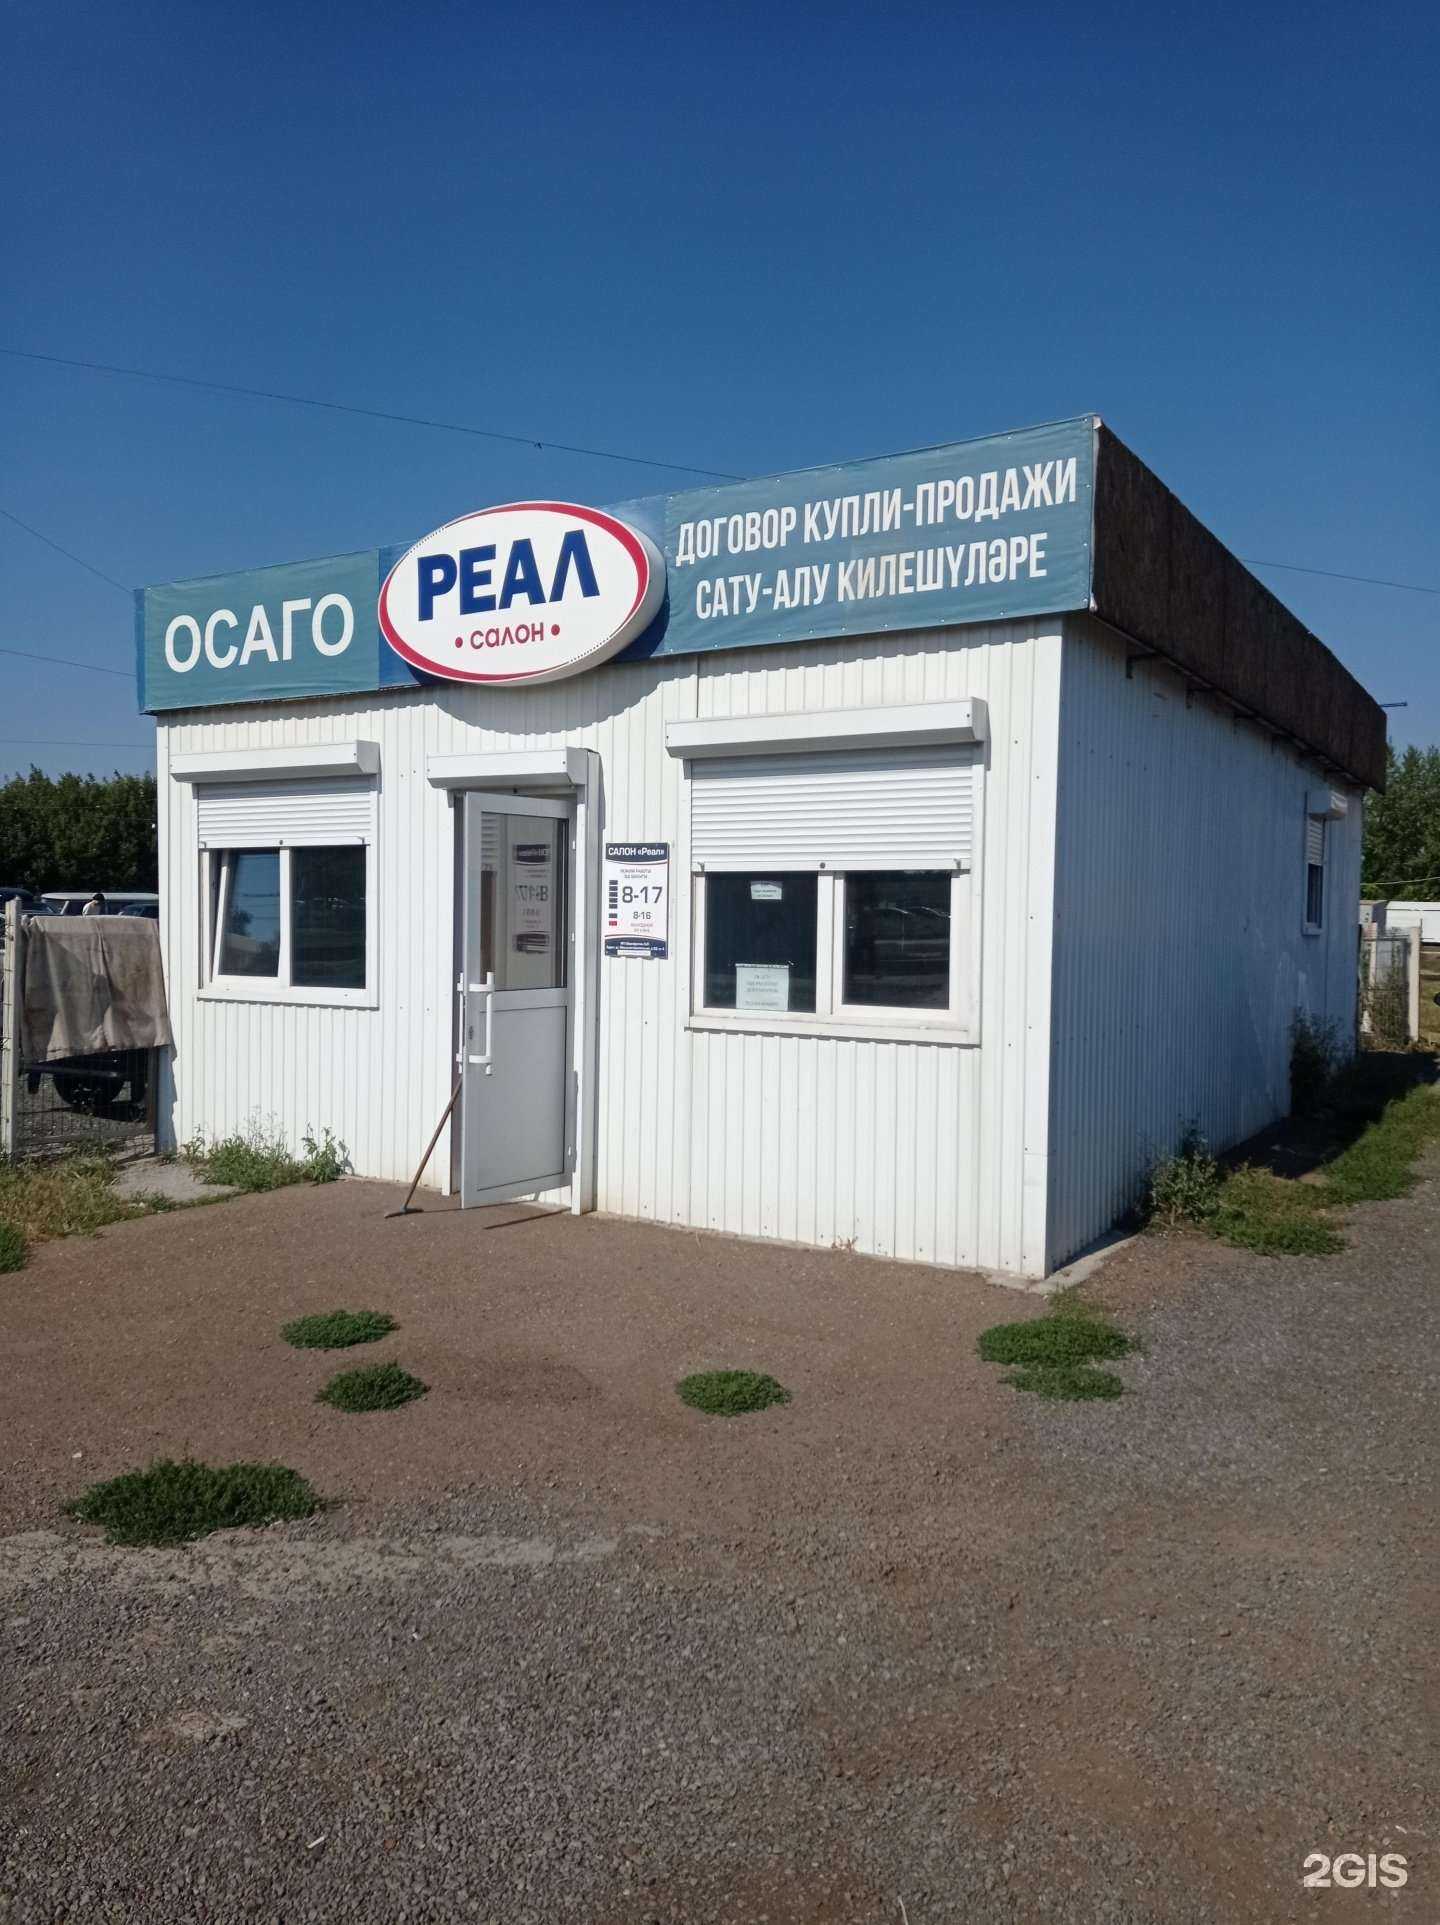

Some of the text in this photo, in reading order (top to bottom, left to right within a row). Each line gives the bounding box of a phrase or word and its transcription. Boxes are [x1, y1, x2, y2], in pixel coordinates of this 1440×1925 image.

[675, 457, 1077, 567] ДОГОВОР КУПЛИ-ПРОДАЖИ
[417, 529, 600, 621] РЕАЛ
[695, 563, 831, 620] САТУ-АЛУ
[165, 593, 354, 673] ОСАГО
[470, 622, 544, 650] салон
[608, 847, 637, 856] САЛОН
[622, 886, 663, 904] 8-17
[633, 911, 652, 920] 8-16
